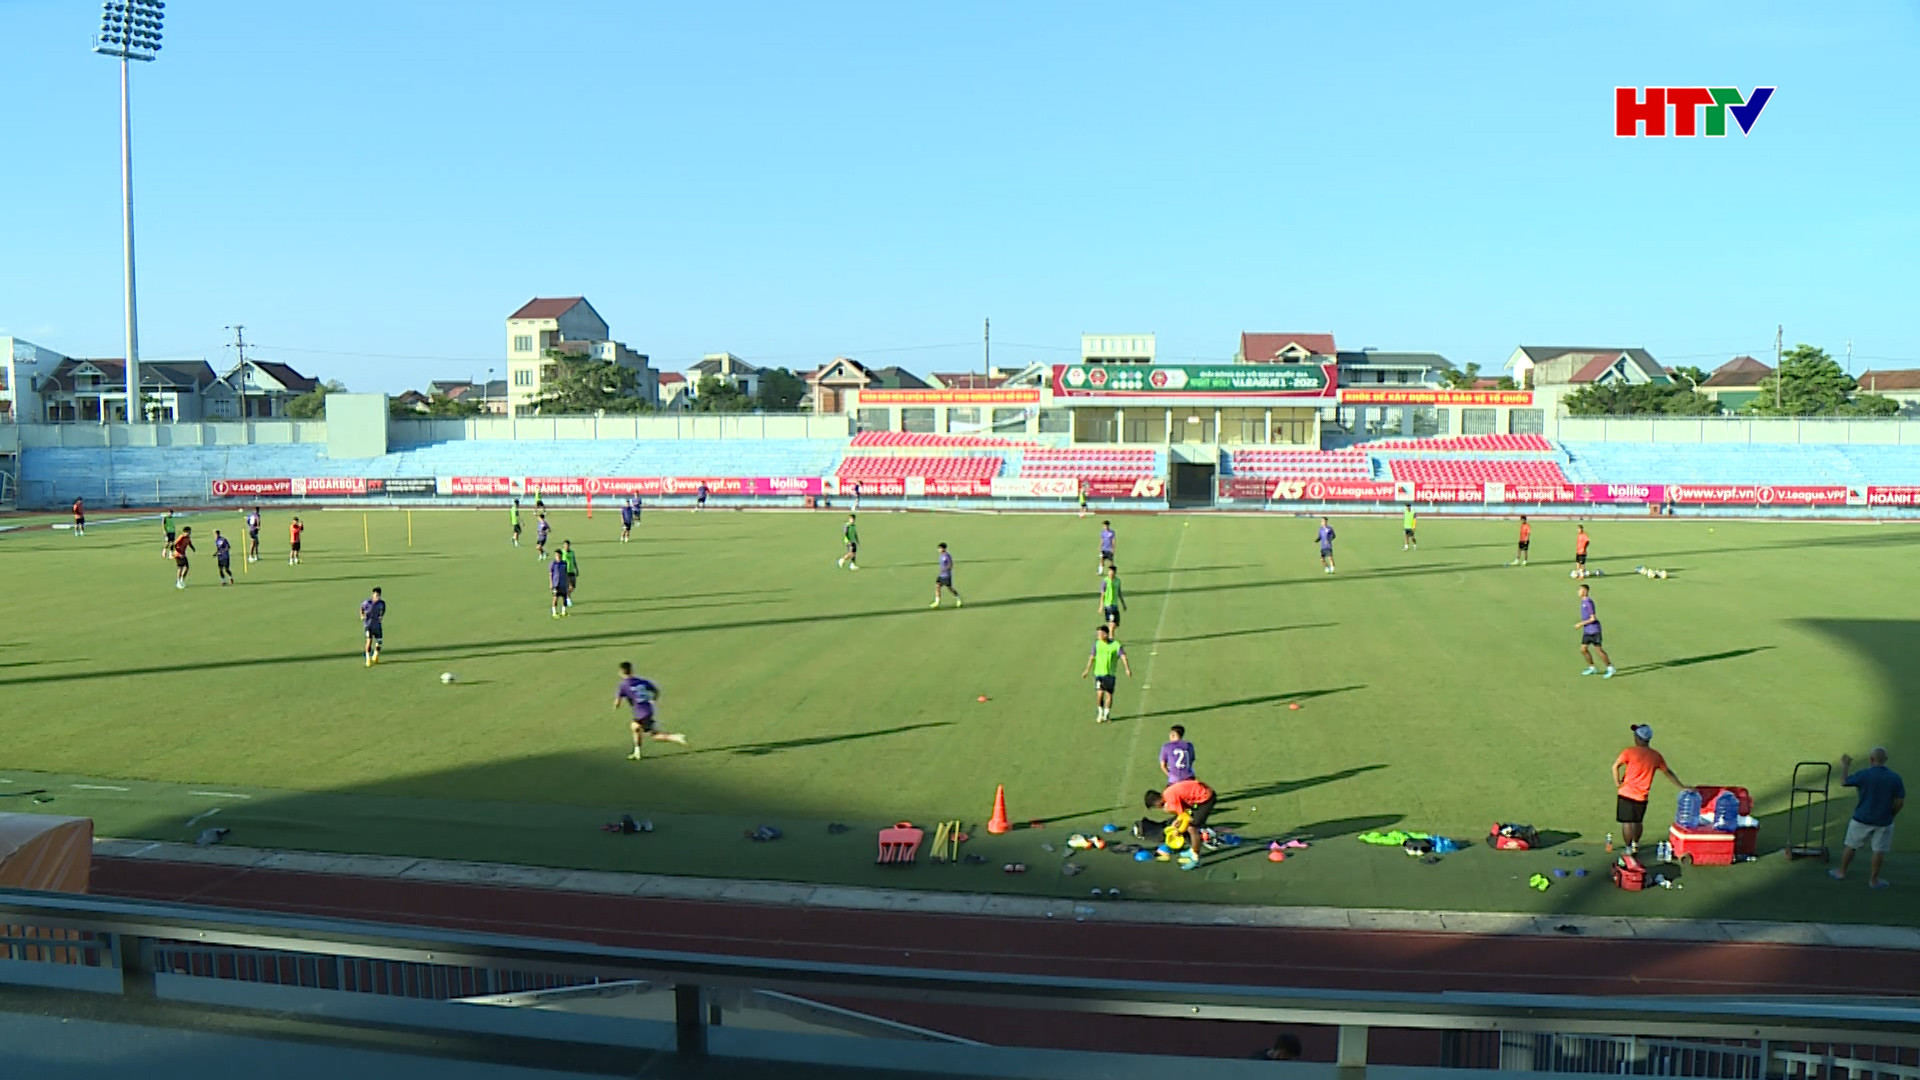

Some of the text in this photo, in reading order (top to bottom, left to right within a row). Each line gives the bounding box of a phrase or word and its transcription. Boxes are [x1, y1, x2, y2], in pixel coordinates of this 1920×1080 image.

[678, 479, 741, 493] wwwvpf.vn
[1608, 485, 1649, 497] Noliko
[1684, 488, 1754, 501] www.vpf.vn
[1777, 490, 1846, 501] V.League.VPF
